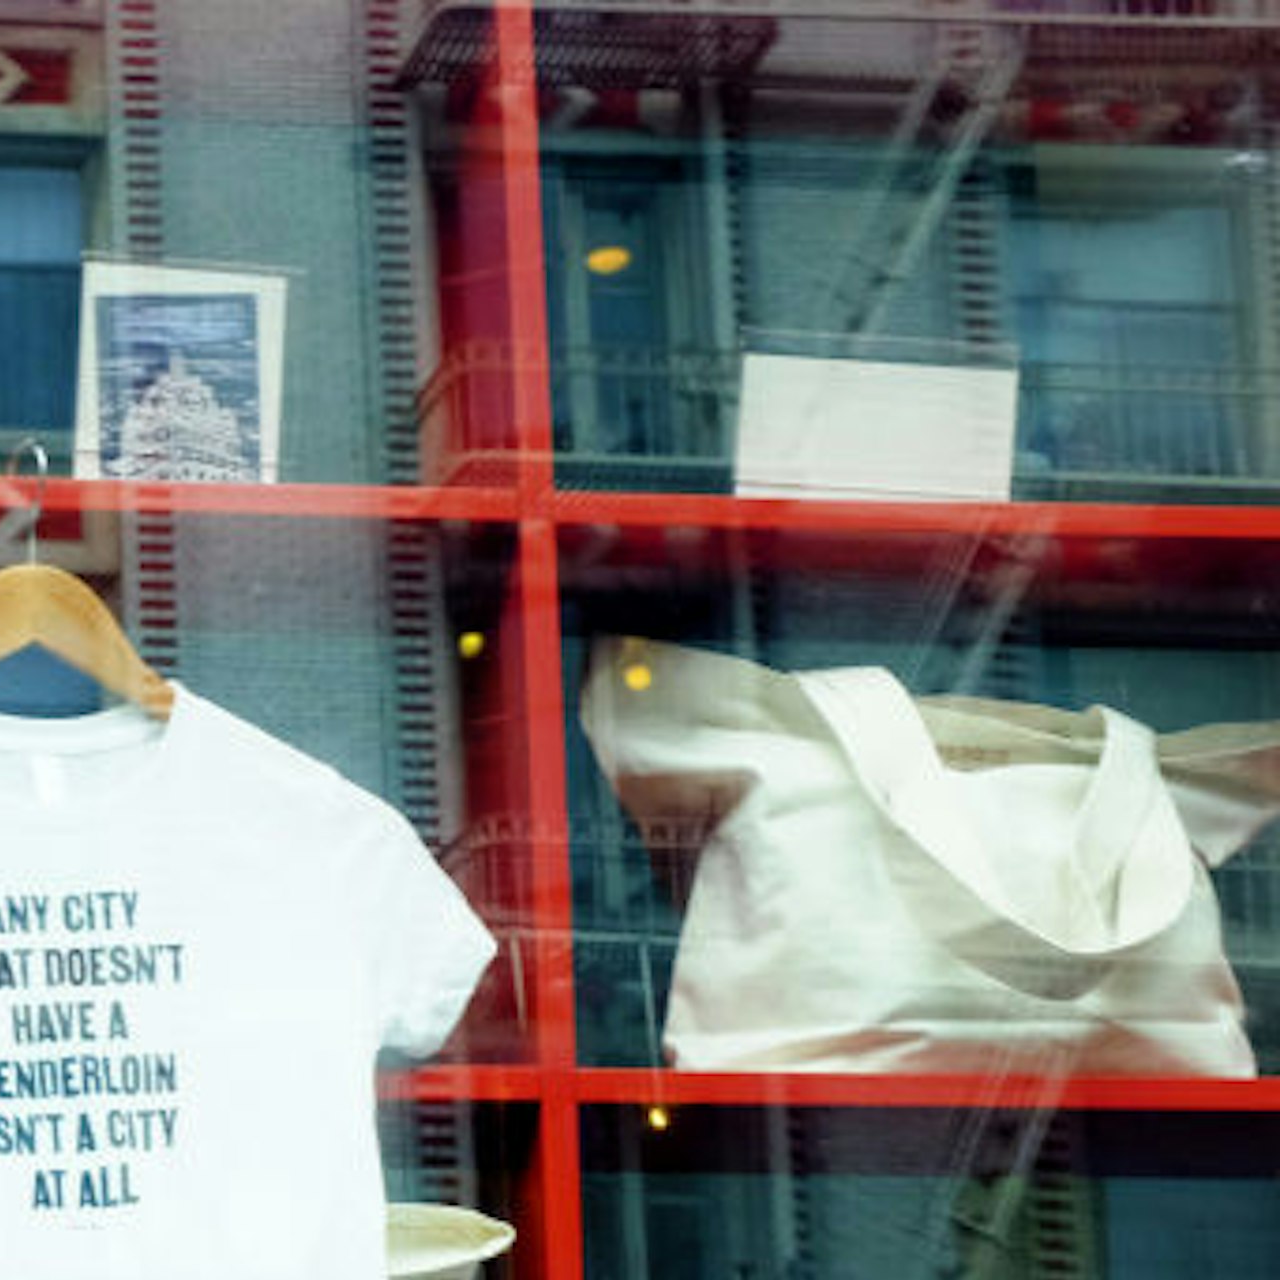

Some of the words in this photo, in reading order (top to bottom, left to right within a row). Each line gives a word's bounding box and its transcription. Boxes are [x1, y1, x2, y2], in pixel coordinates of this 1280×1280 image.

[61, 891, 139, 934] CITY
[43, 943, 184, 987] DOESN'T
[11, 1001, 97, 1046] HAVE
[108, 1000, 130, 1041] A
[75, 1111, 97, 1155] A
[106, 1108, 179, 1152] CITY
[31, 1168, 67, 1210] AT
[78, 1162, 140, 1209] ALL
